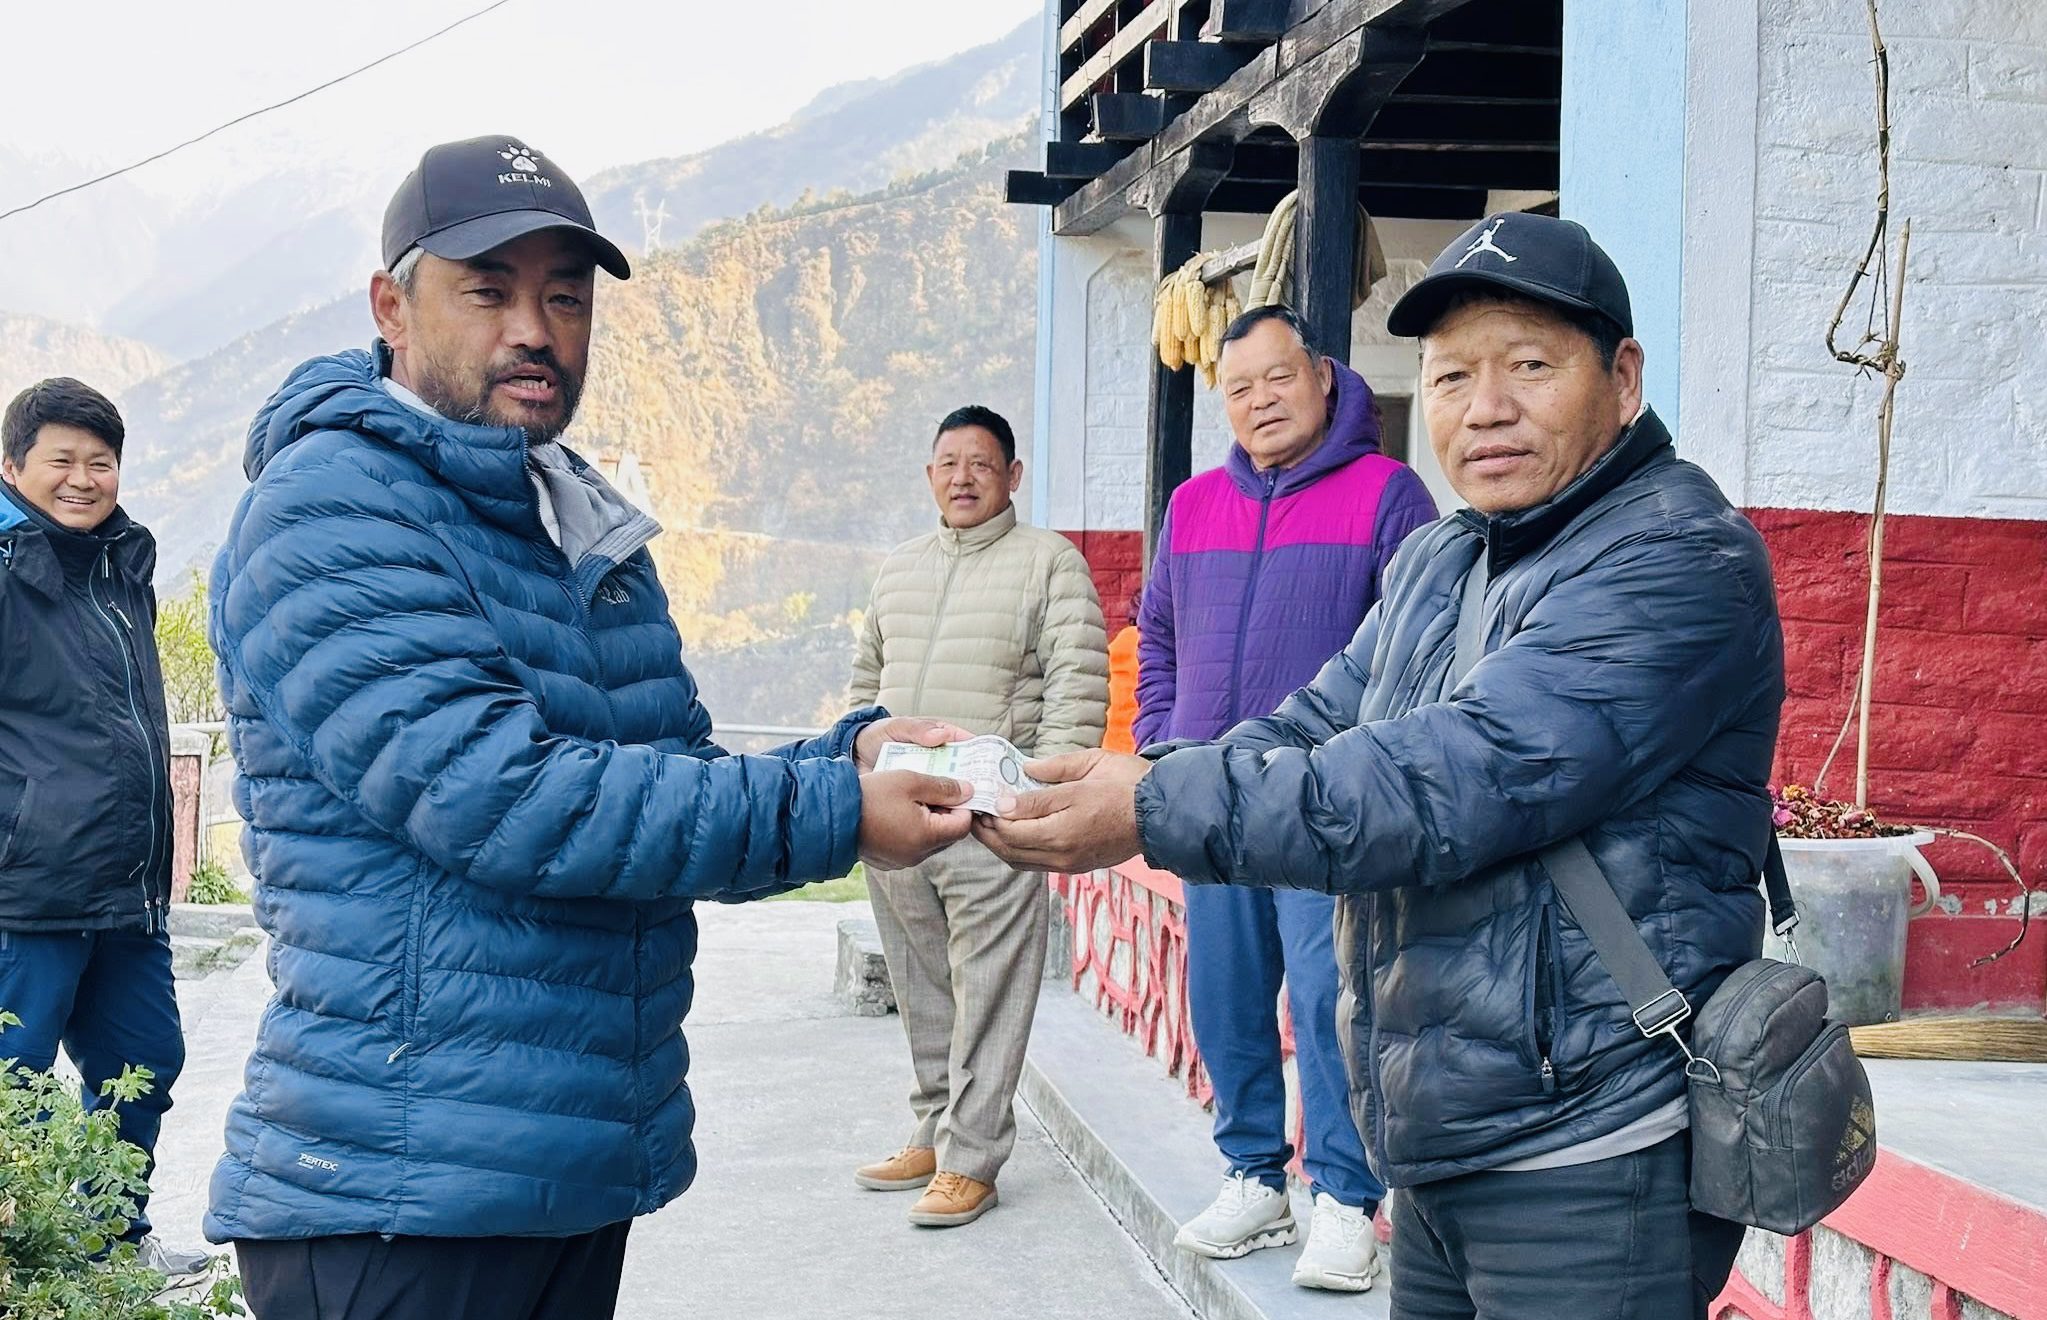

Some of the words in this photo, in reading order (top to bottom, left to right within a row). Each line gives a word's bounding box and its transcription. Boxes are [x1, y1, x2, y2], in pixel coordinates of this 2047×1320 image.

[497, 172, 552, 188] KELM
[299, 1152, 339, 1171] PERTEX
[1831, 1139, 1875, 1191] adid
